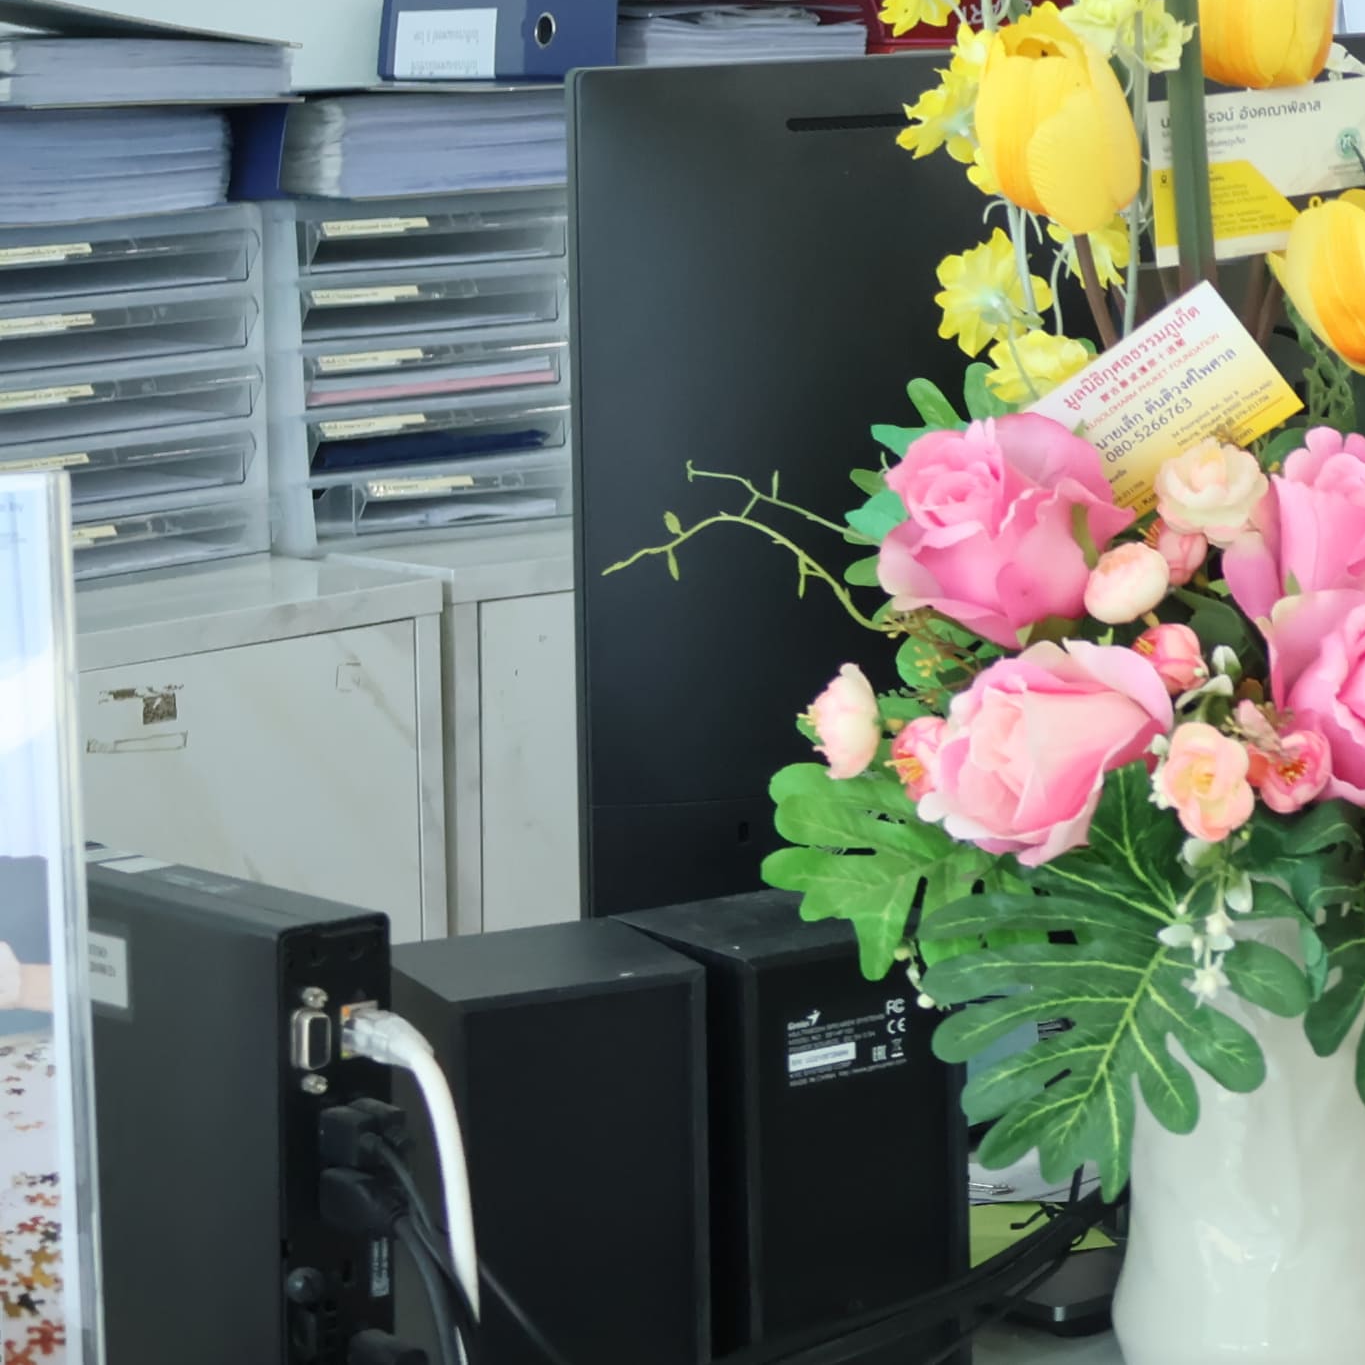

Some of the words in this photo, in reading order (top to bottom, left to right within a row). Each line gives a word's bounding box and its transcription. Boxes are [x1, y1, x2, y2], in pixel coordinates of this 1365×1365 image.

[1064, 306, 1200, 410] มูลนิธิกุศลธรรมภูเก็ต
[1095, 413, 1144, 451] นายเล็ก
[1144, 349, 1237, 415] ตันติวงศ์ไพศาล
[1106, 397, 1193, 464] 080-5266763
